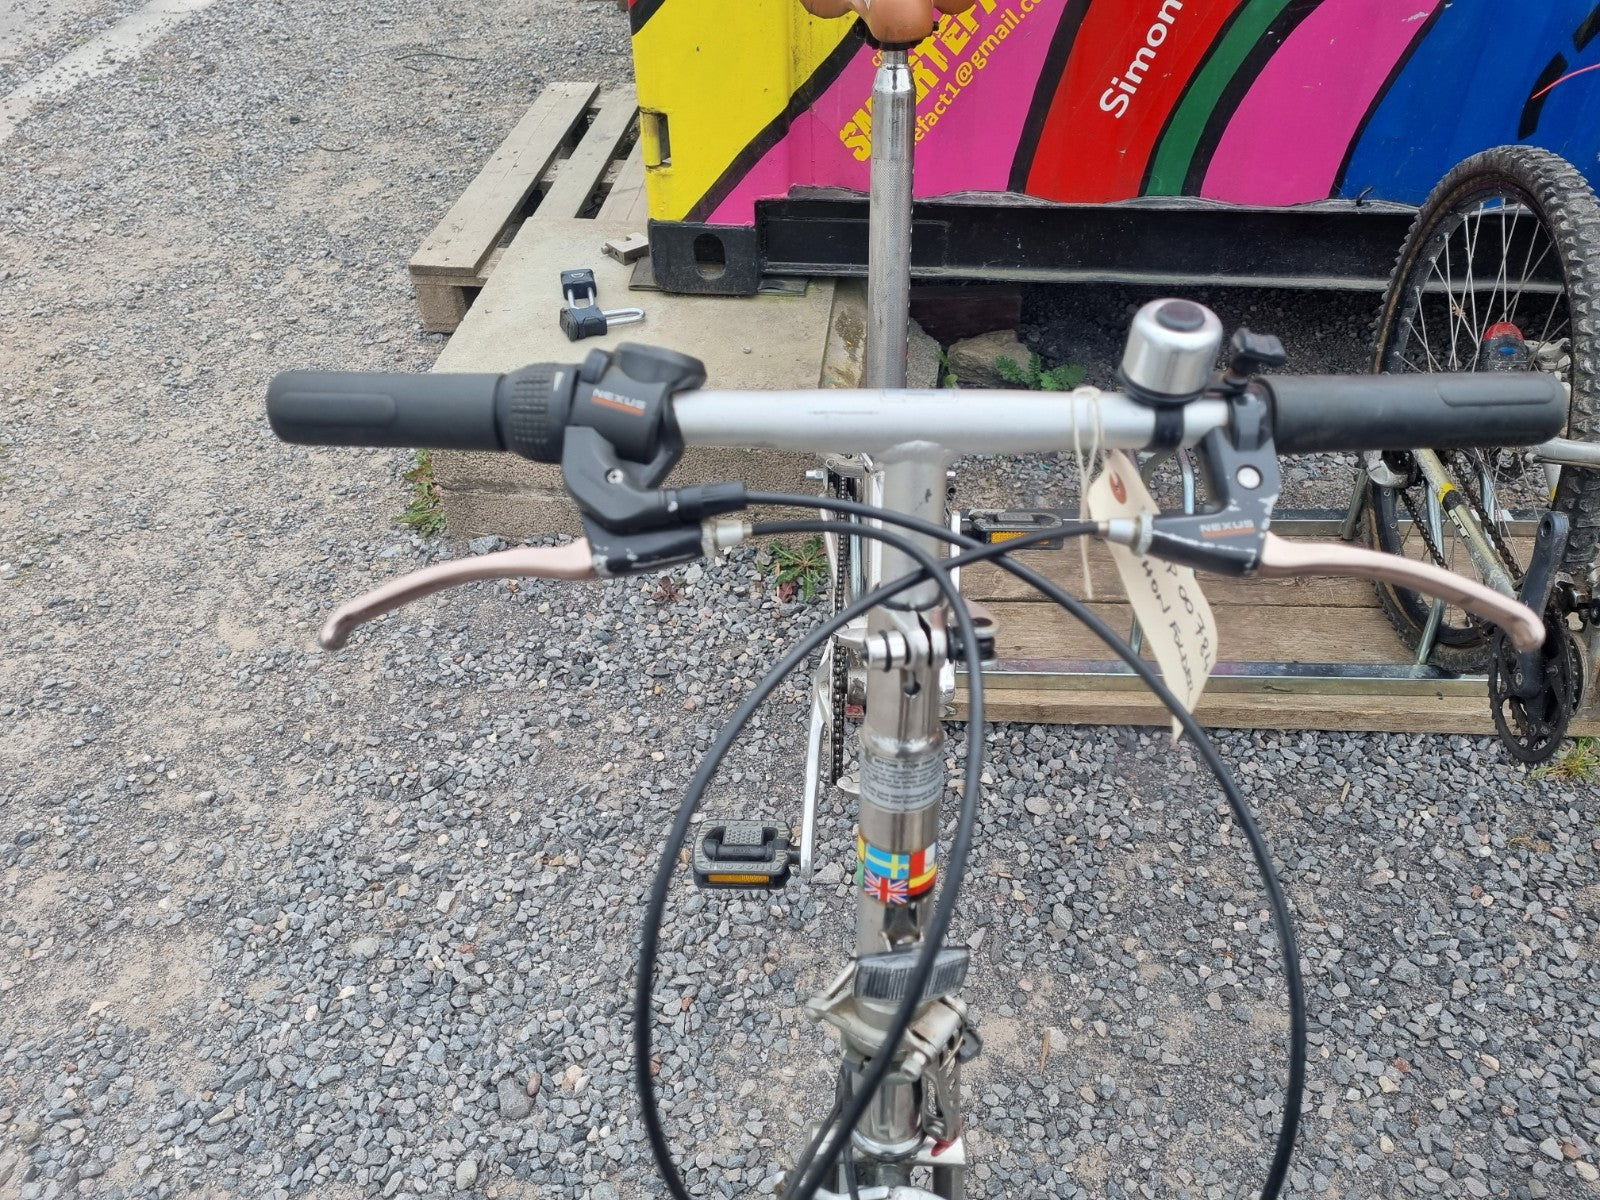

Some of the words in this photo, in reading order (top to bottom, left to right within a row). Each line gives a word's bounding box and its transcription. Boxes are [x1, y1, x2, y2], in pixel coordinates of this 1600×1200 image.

[1099, 0, 1184, 119] Simon
[592, 388, 648, 410] NEXUS
[1199, 519, 1255, 533] NEXUS
